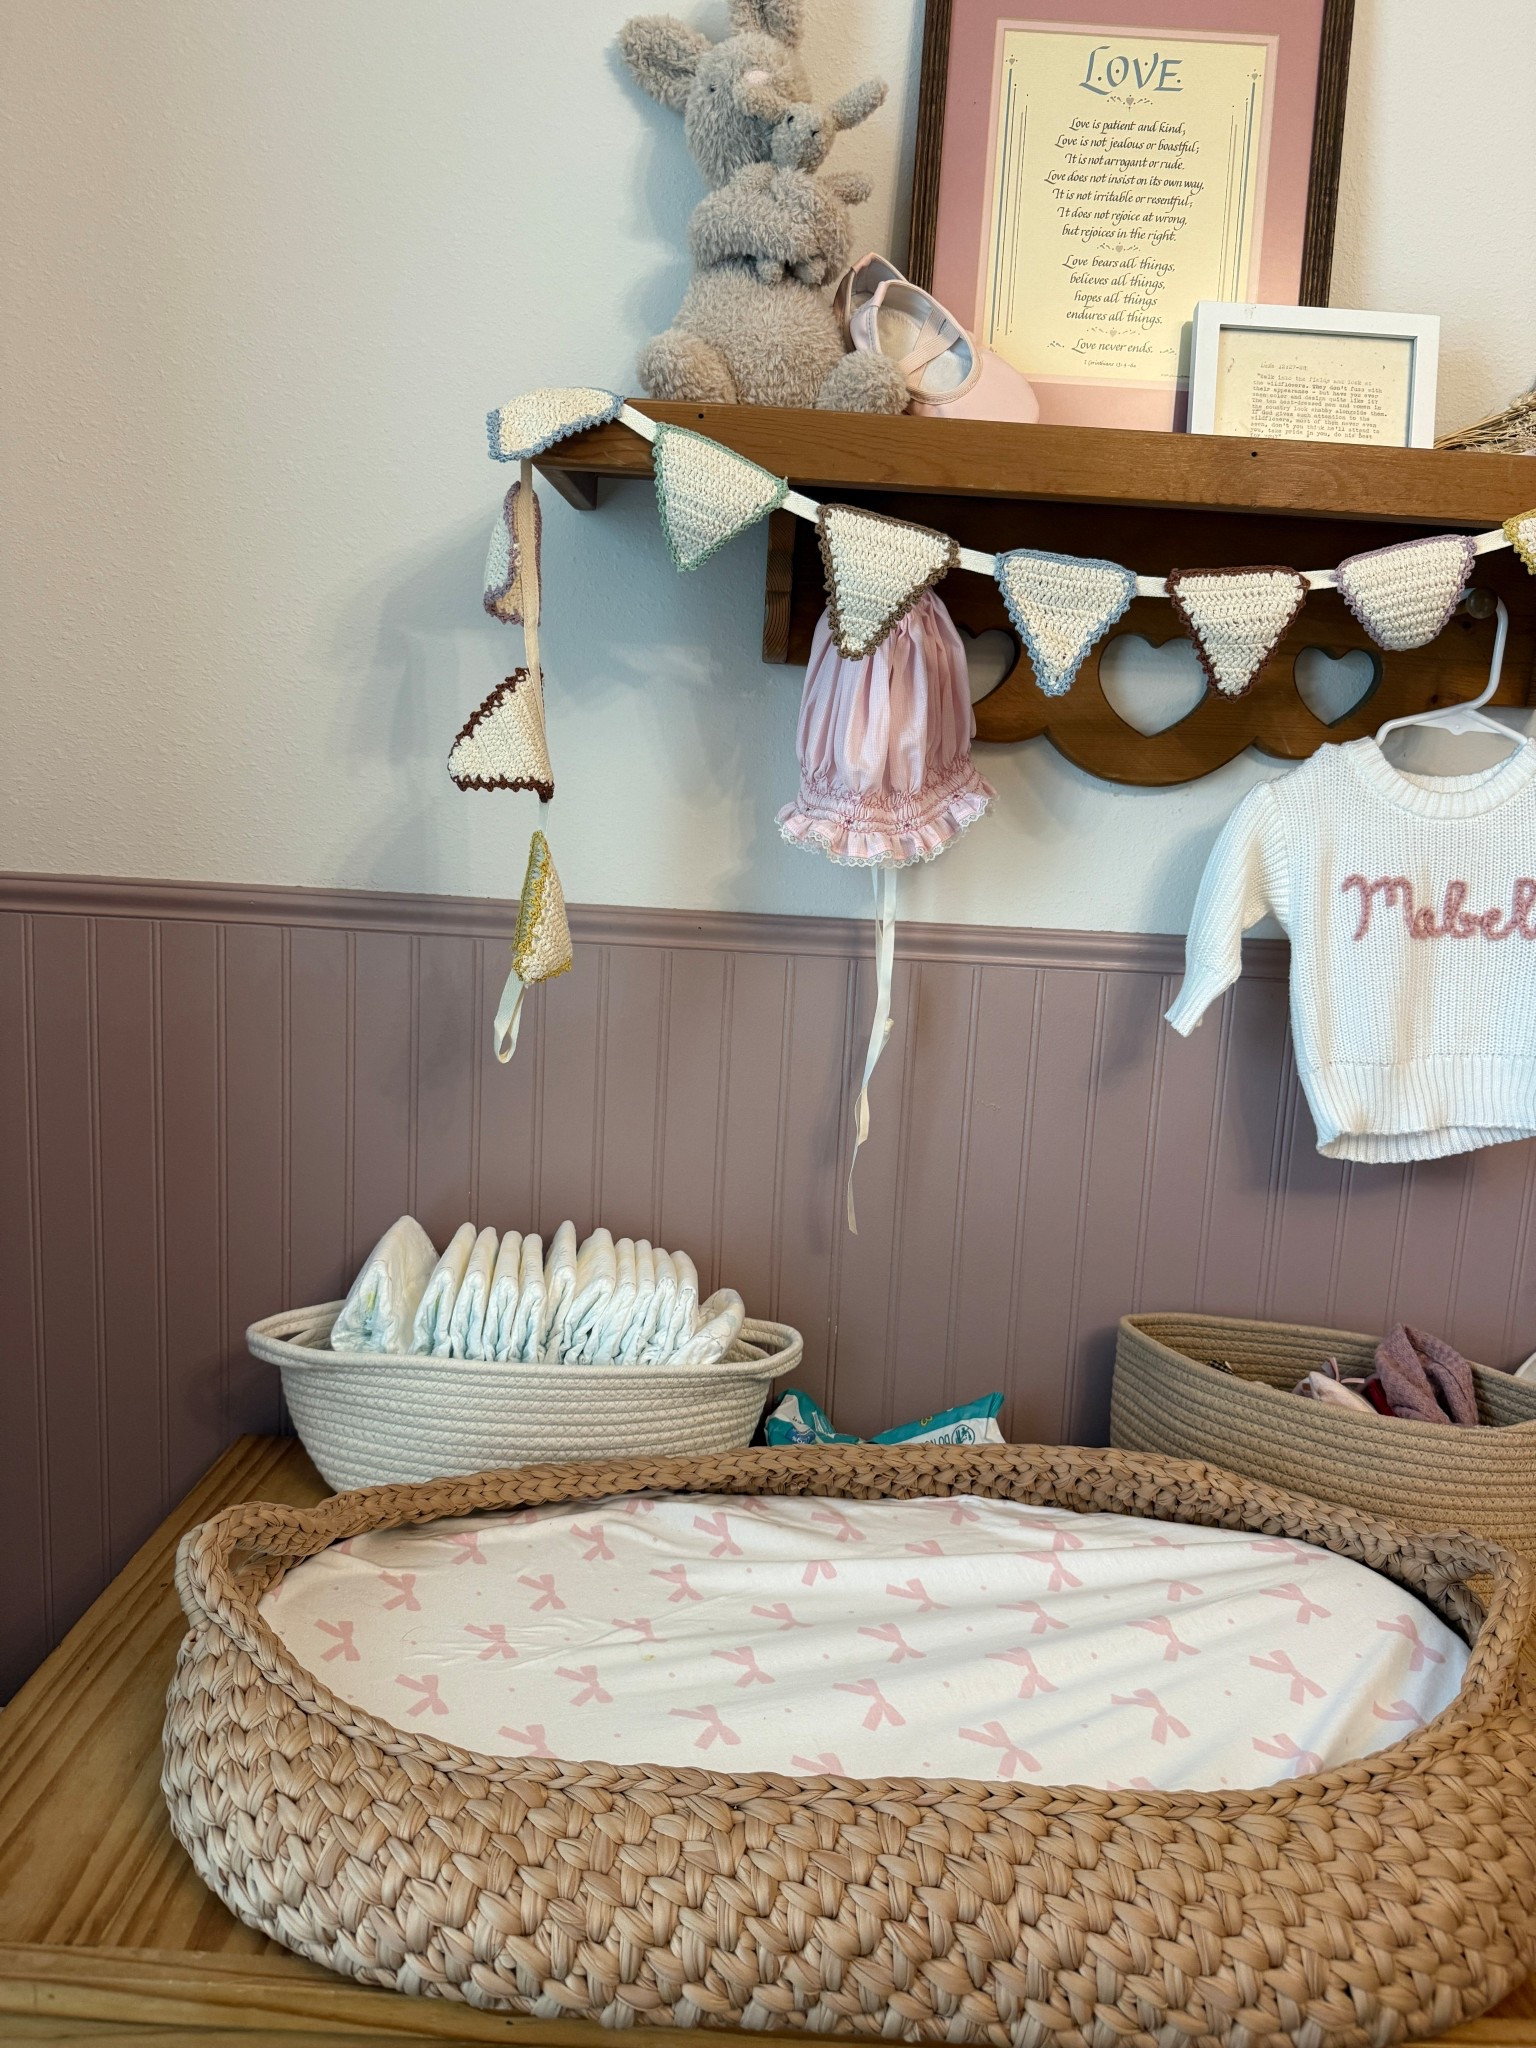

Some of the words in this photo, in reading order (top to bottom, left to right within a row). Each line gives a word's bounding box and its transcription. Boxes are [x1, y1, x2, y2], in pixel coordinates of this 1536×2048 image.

[1079, 46, 1184, 95] LOVE
[1069, 117, 1090, 131] Love
[1092, 120, 1101, 129] is
[1100, 120, 1136, 134] patient
[1138, 121, 1159, 132] and
[1054, 134, 1078, 148] Love
[1080, 136, 1089, 146] is
[1090, 137, 1107, 147] not
[1105, 137, 1144, 152] jealous
[1146, 142, 1156, 150] or
[1158, 139, 1200, 157] boastful;
[1064, 153, 1078, 164] It
[1078, 154, 1087, 164] is
[1088, 155, 1104, 165] not
[1104, 157, 1148, 172] arrogant
[1160, 158, 1184, 170] rude.
[1044, 170, 1066, 184] Love
[1067, 170, 1088, 182] does
[1090, 174, 1107, 182] not
[1108, 174, 1136, 184] insist
[1150, 176, 1162, 186] its
[1052, 188, 1064, 199] It
[1066, 190, 1074, 200] is
[1076, 190, 1092, 200] not
[1094, 190, 1133, 202] irritable
[1146, 195, 1194, 213] resentful;
[1057, 206, 1070, 218] It
[1071, 206, 1092, 218] does
[1094, 210, 1110, 220] not
[1111, 210, 1140, 226] rejoice
[1142, 212, 1154, 222] at
[1062, 224, 1080, 236] but
[1081, 226, 1116, 243] rejoices
[1117, 228, 1128, 238] in
[1130, 226, 1146, 240] the
[1148, 229, 1176, 246] right.
[1062, 254, 1088, 269] Love
[1092, 256, 1119, 268] bears
[1120, 256, 1139, 268] all
[1140, 256, 1175, 276] things,
[1070, 272, 1109, 285] believes
[1111, 272, 1130, 286] all
[1130, 274, 1165, 295] things,
[1074, 290, 1102, 308] hopes
[1104, 290, 1124, 303] all
[1124, 292, 1158, 311] things
[1066, 308, 1108, 320] endures
[1108, 310, 1126, 322] all
[1127, 310, 1162, 330] things.
[1072, 338, 1096, 354] Love
[1099, 344, 1127, 352] never
[1128, 341, 1152, 353] ends.
[1341, 873, 1536, 943] Mabel
